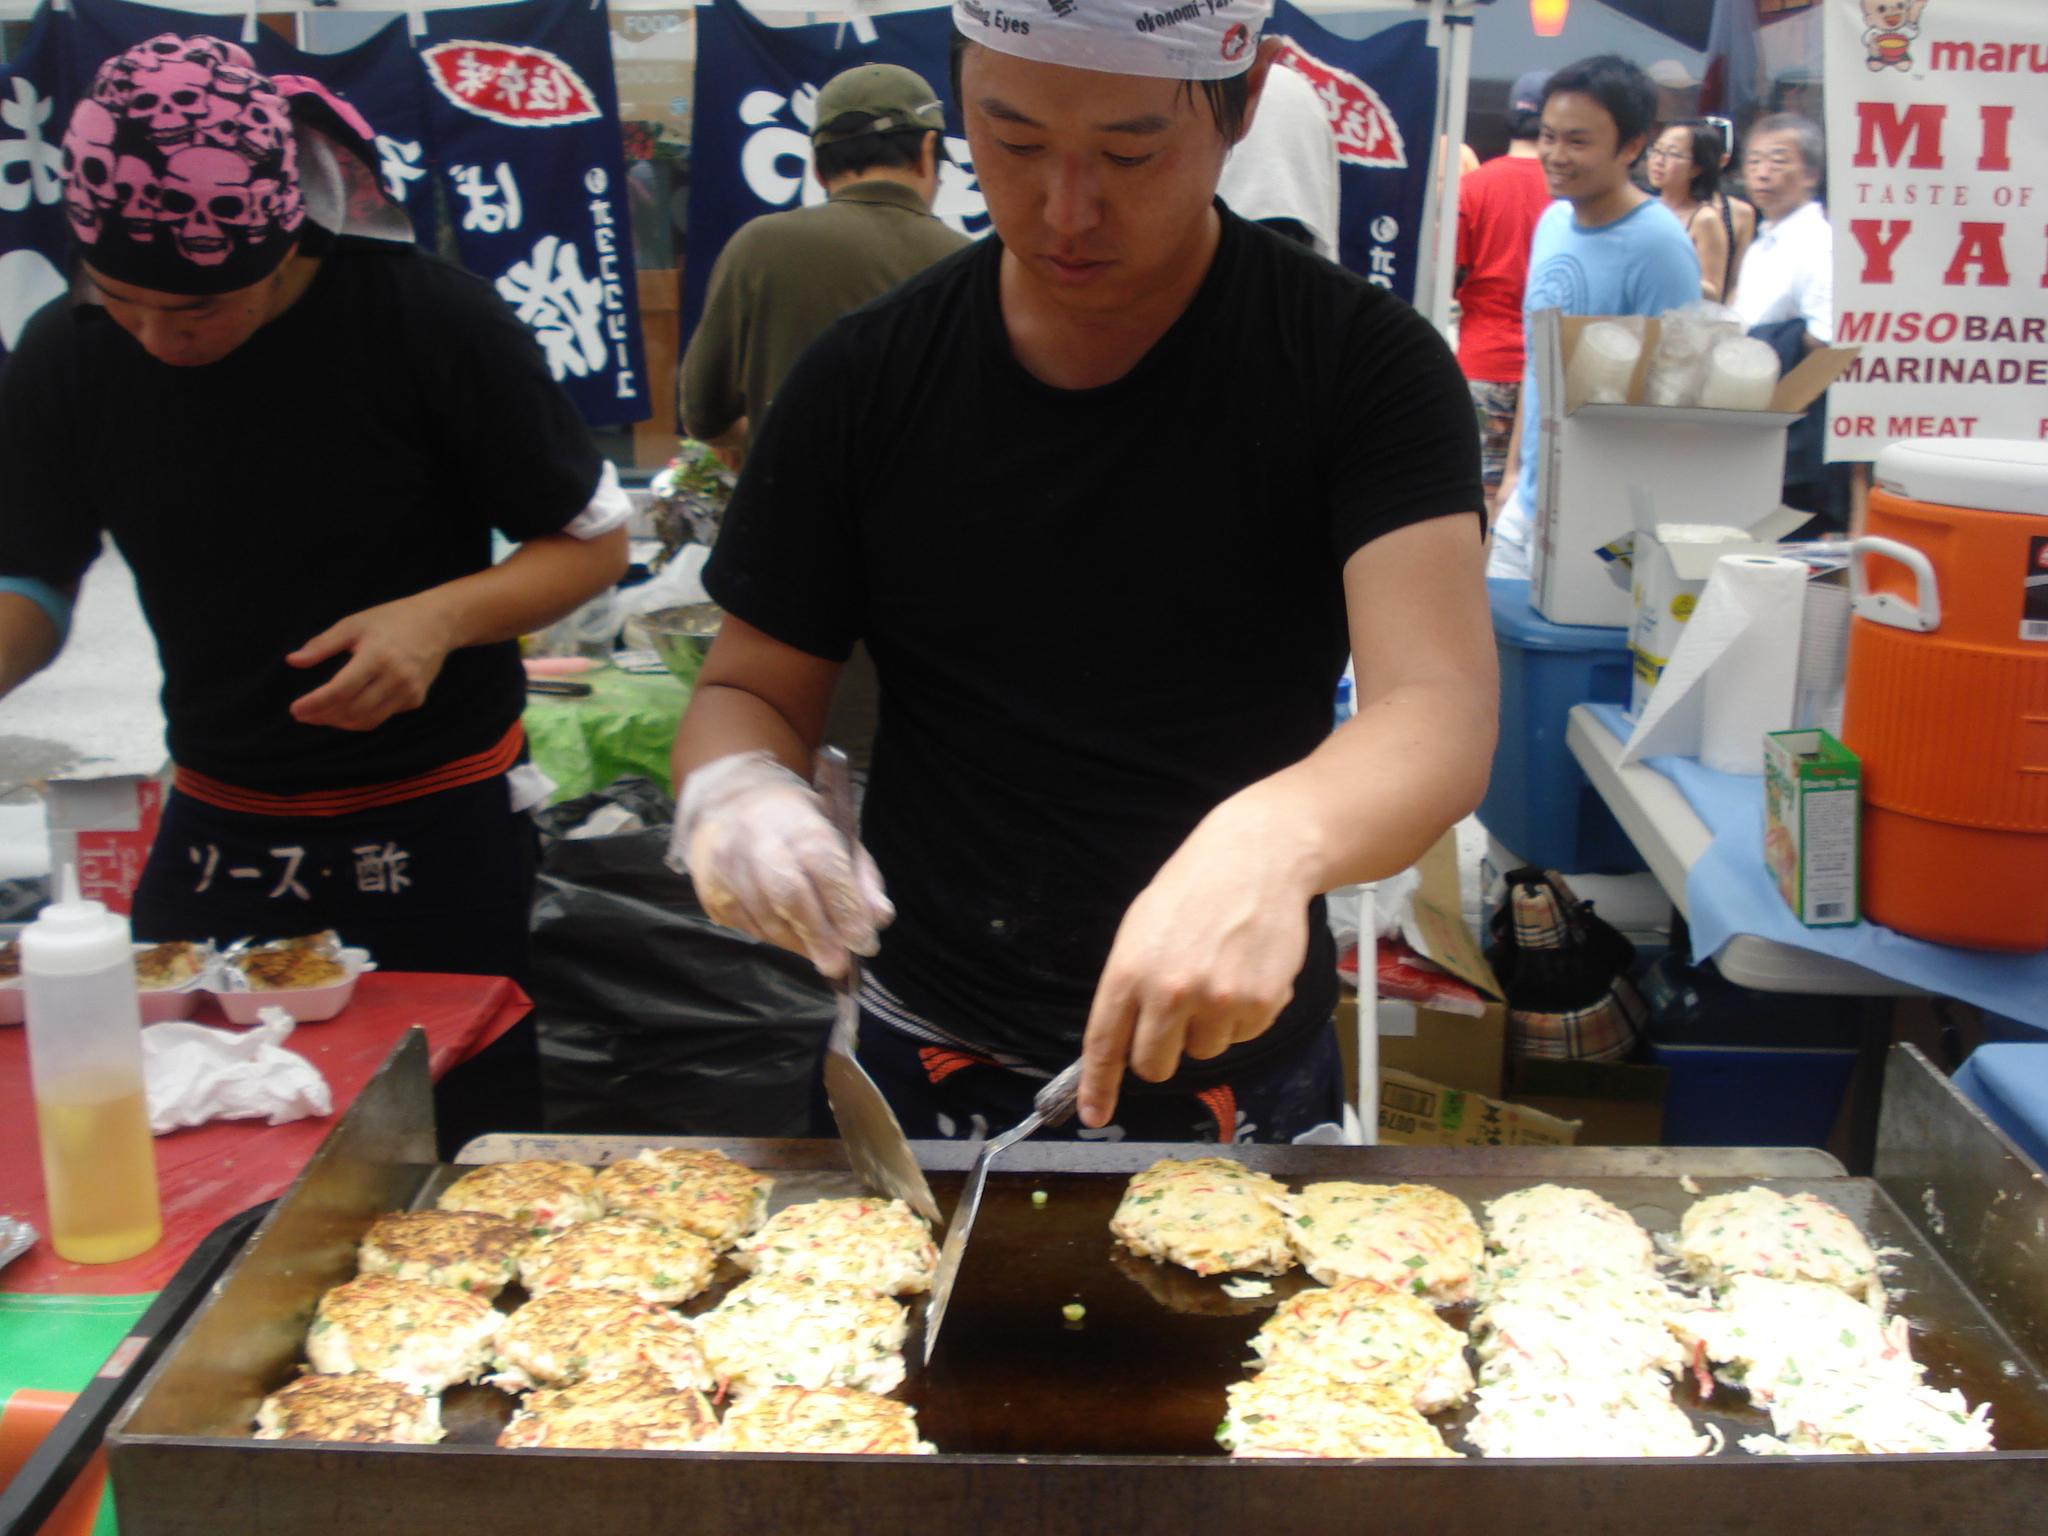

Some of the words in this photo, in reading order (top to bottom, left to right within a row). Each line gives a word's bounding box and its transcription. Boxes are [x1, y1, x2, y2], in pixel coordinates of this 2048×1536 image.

[994, 10, 1030, 35] Eyes
[1929, 41, 2048, 74] maru
[1852, 101, 2014, 172] MI
[1857, 183, 1969, 206] TASTE
[1992, 186, 2034, 208] OF
[1849, 219, 2048, 288] YA
[1837, 312, 1959, 344] MISO
[1963, 316, 2048, 344] BAR
[1834, 416, 1876, 437] OR
[1888, 416, 1978, 438] MEAT
